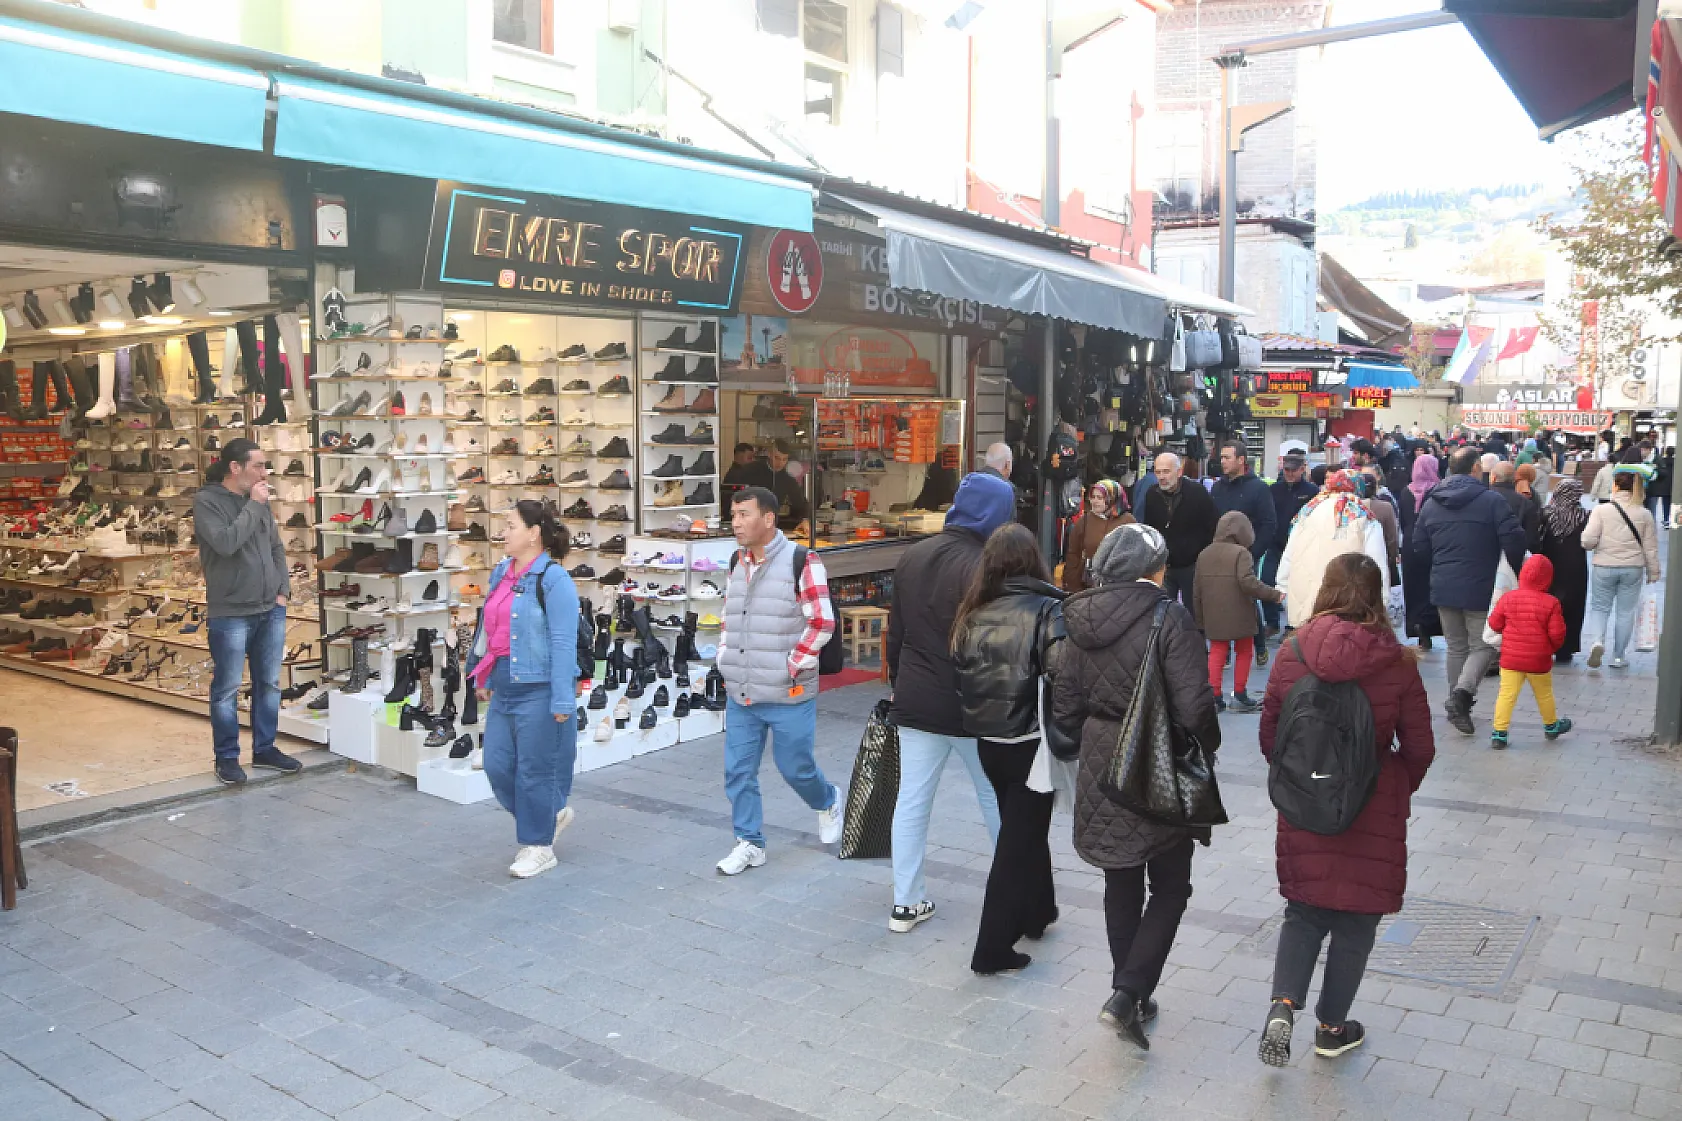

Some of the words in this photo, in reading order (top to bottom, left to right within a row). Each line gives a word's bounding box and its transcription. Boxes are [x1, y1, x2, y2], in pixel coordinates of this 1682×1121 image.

[473, 207, 604, 269] EMRE
[616, 228, 722, 284] SPOR
[519, 275, 575, 295] LOVE
[580, 281, 601, 297] IN
[607, 283, 673, 304] SHOES
